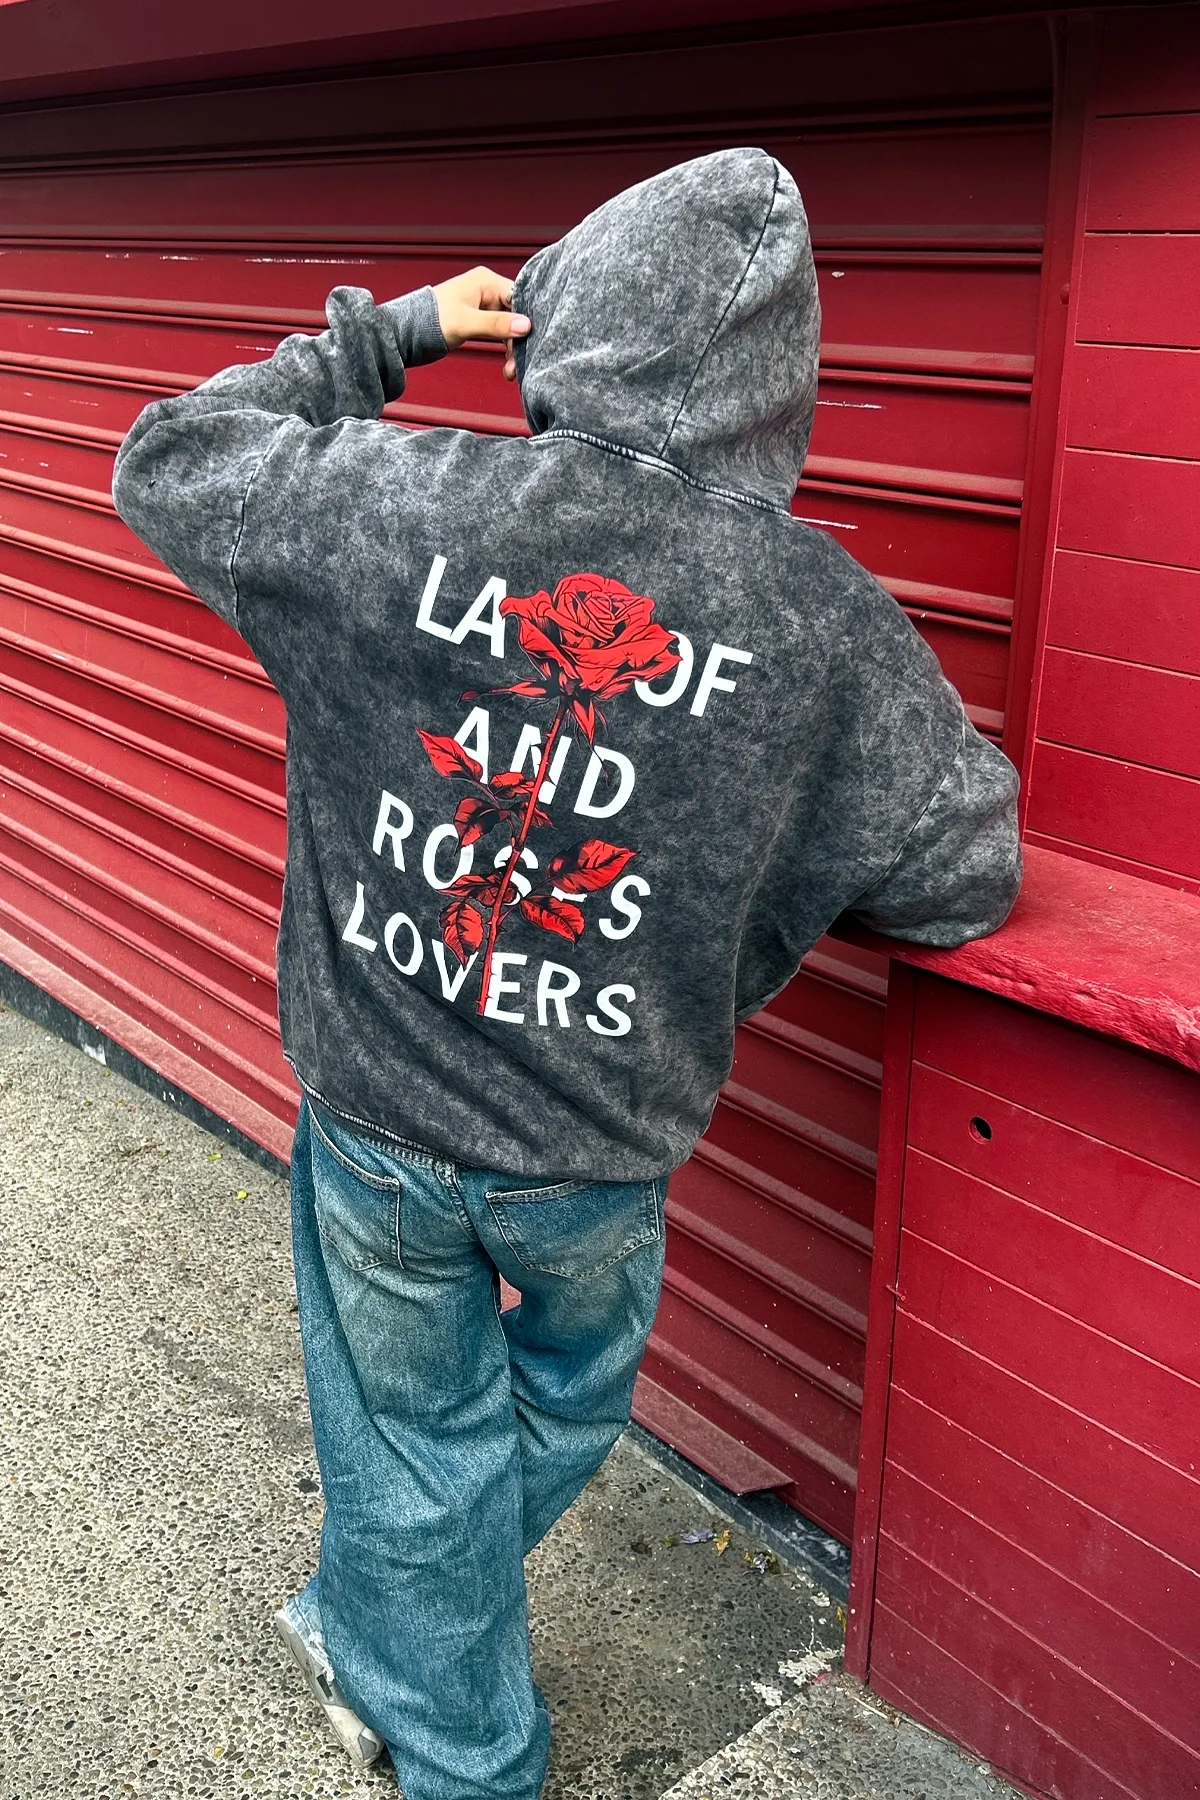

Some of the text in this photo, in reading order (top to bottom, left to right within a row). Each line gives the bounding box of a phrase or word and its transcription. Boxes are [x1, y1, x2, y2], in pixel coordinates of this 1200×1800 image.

[635, 630, 754, 717] OF
[453, 706, 636, 819] AND
[372, 790, 652, 940] ROSS
[341, 881, 637, 1037] LOVERS
